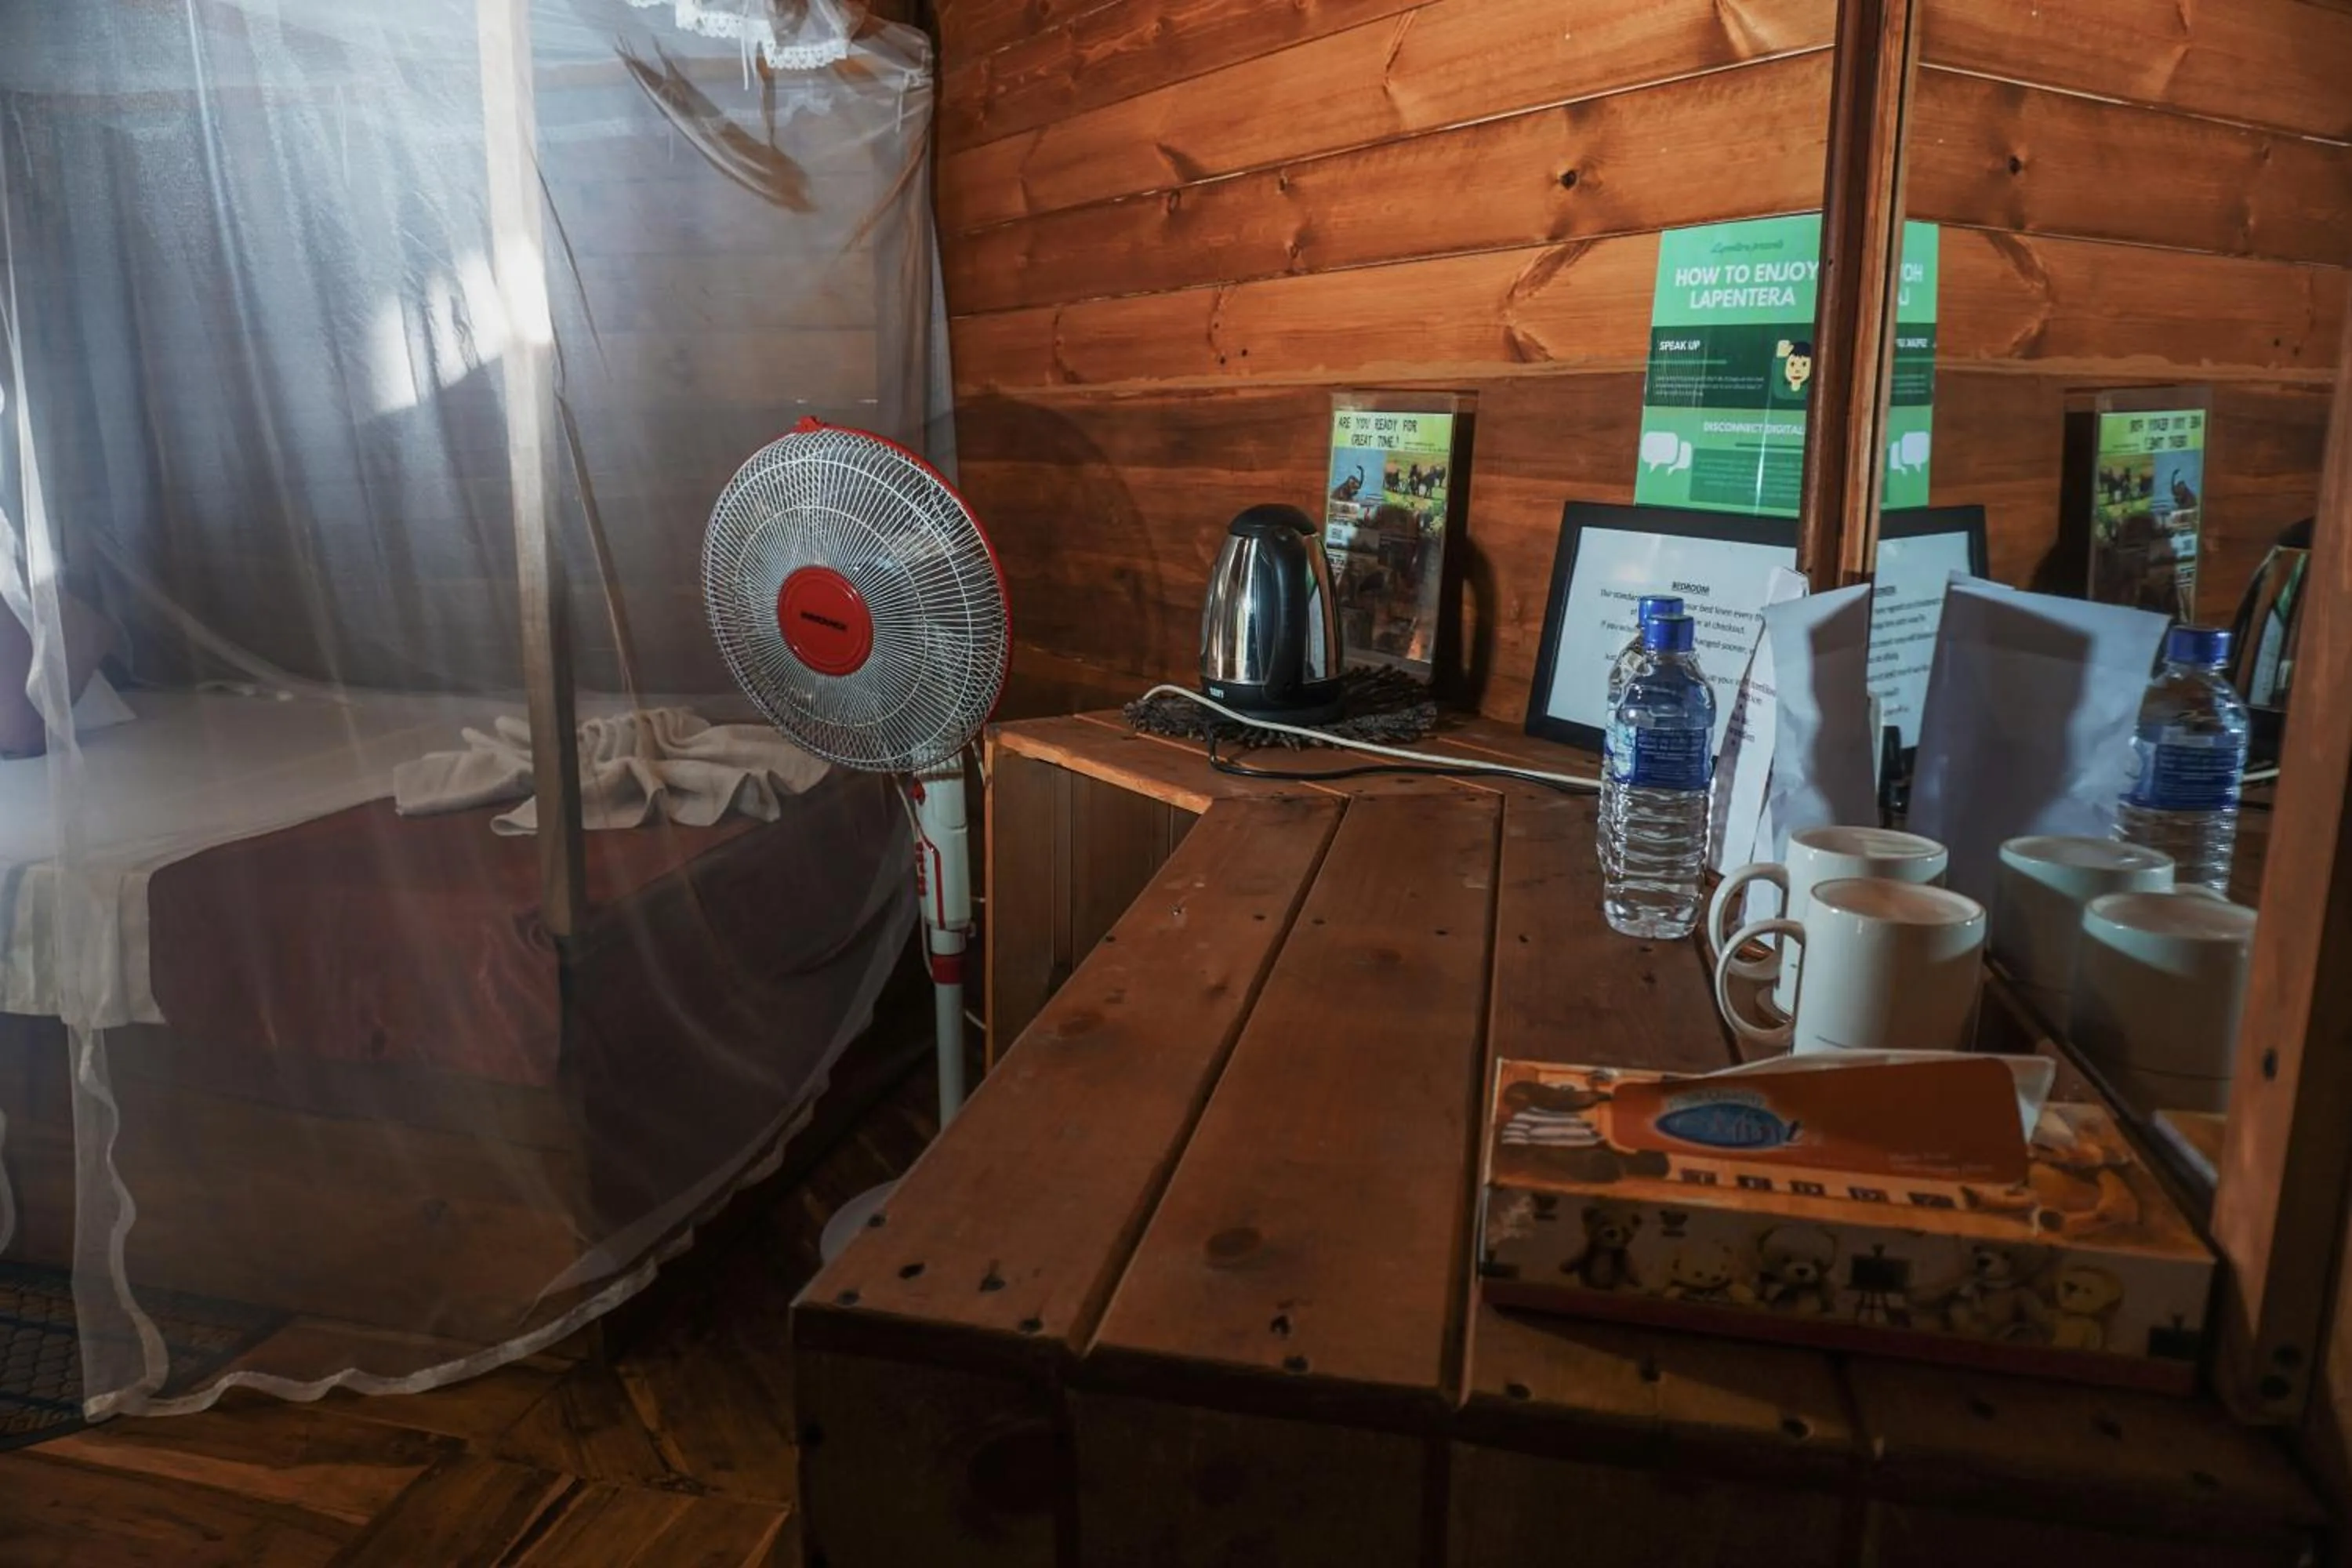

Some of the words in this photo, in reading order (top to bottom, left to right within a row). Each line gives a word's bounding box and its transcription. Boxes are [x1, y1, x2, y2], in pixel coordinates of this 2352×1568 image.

[1675, 267, 1720, 287] HOW
[1725, 264, 1749, 284] TO
[1755, 260, 1819, 283] ENJOY
[1690, 286, 1795, 310] LAPENTERA
[1659, 339, 1687, 351] SPEAK
[1688, 339, 1701, 351] UP
[1338, 416, 1352, 429] ARE
[1356, 417, 1371, 430] YOU
[1374, 417, 1398, 431] READY
[1403, 419, 1417, 433] FOR
[1703, 421, 1763, 434] DISCONNECT
[1351, 434, 1372, 446] GREAT
[1671, 581, 1710, 596] BEDROOM
